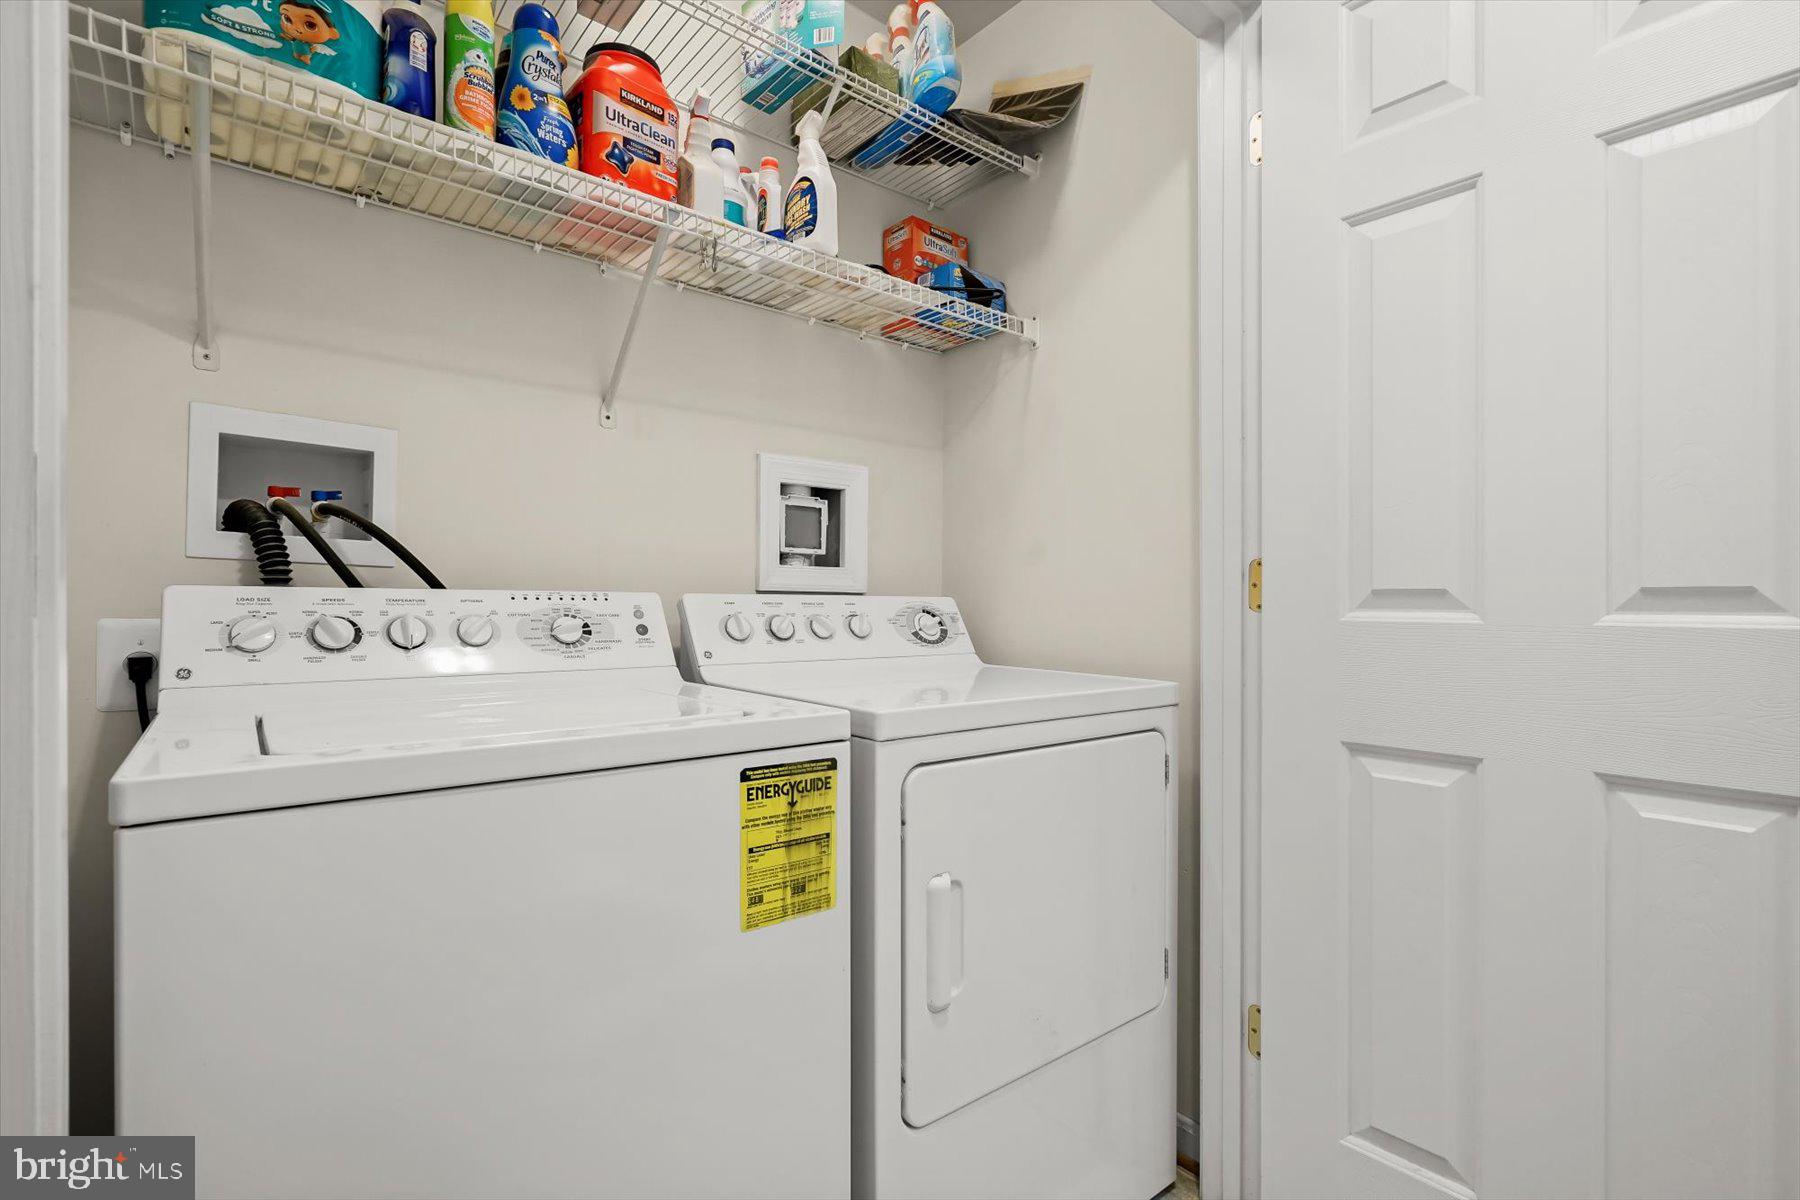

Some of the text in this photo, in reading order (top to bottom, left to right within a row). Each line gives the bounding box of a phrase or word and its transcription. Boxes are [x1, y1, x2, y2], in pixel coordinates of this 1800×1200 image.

[210, 14, 232, 26] SOFT
[241, 26, 276, 39] STRONG
[536, 50, 557, 72] Purex
[621, 90, 663, 115] KIRKLAND
[538, 128, 567, 148] Waters
[540, 121, 564, 138] Spring
[606, 106, 676, 148] UltraClean
[746, 776, 832, 804] ENERGYGUIDE
